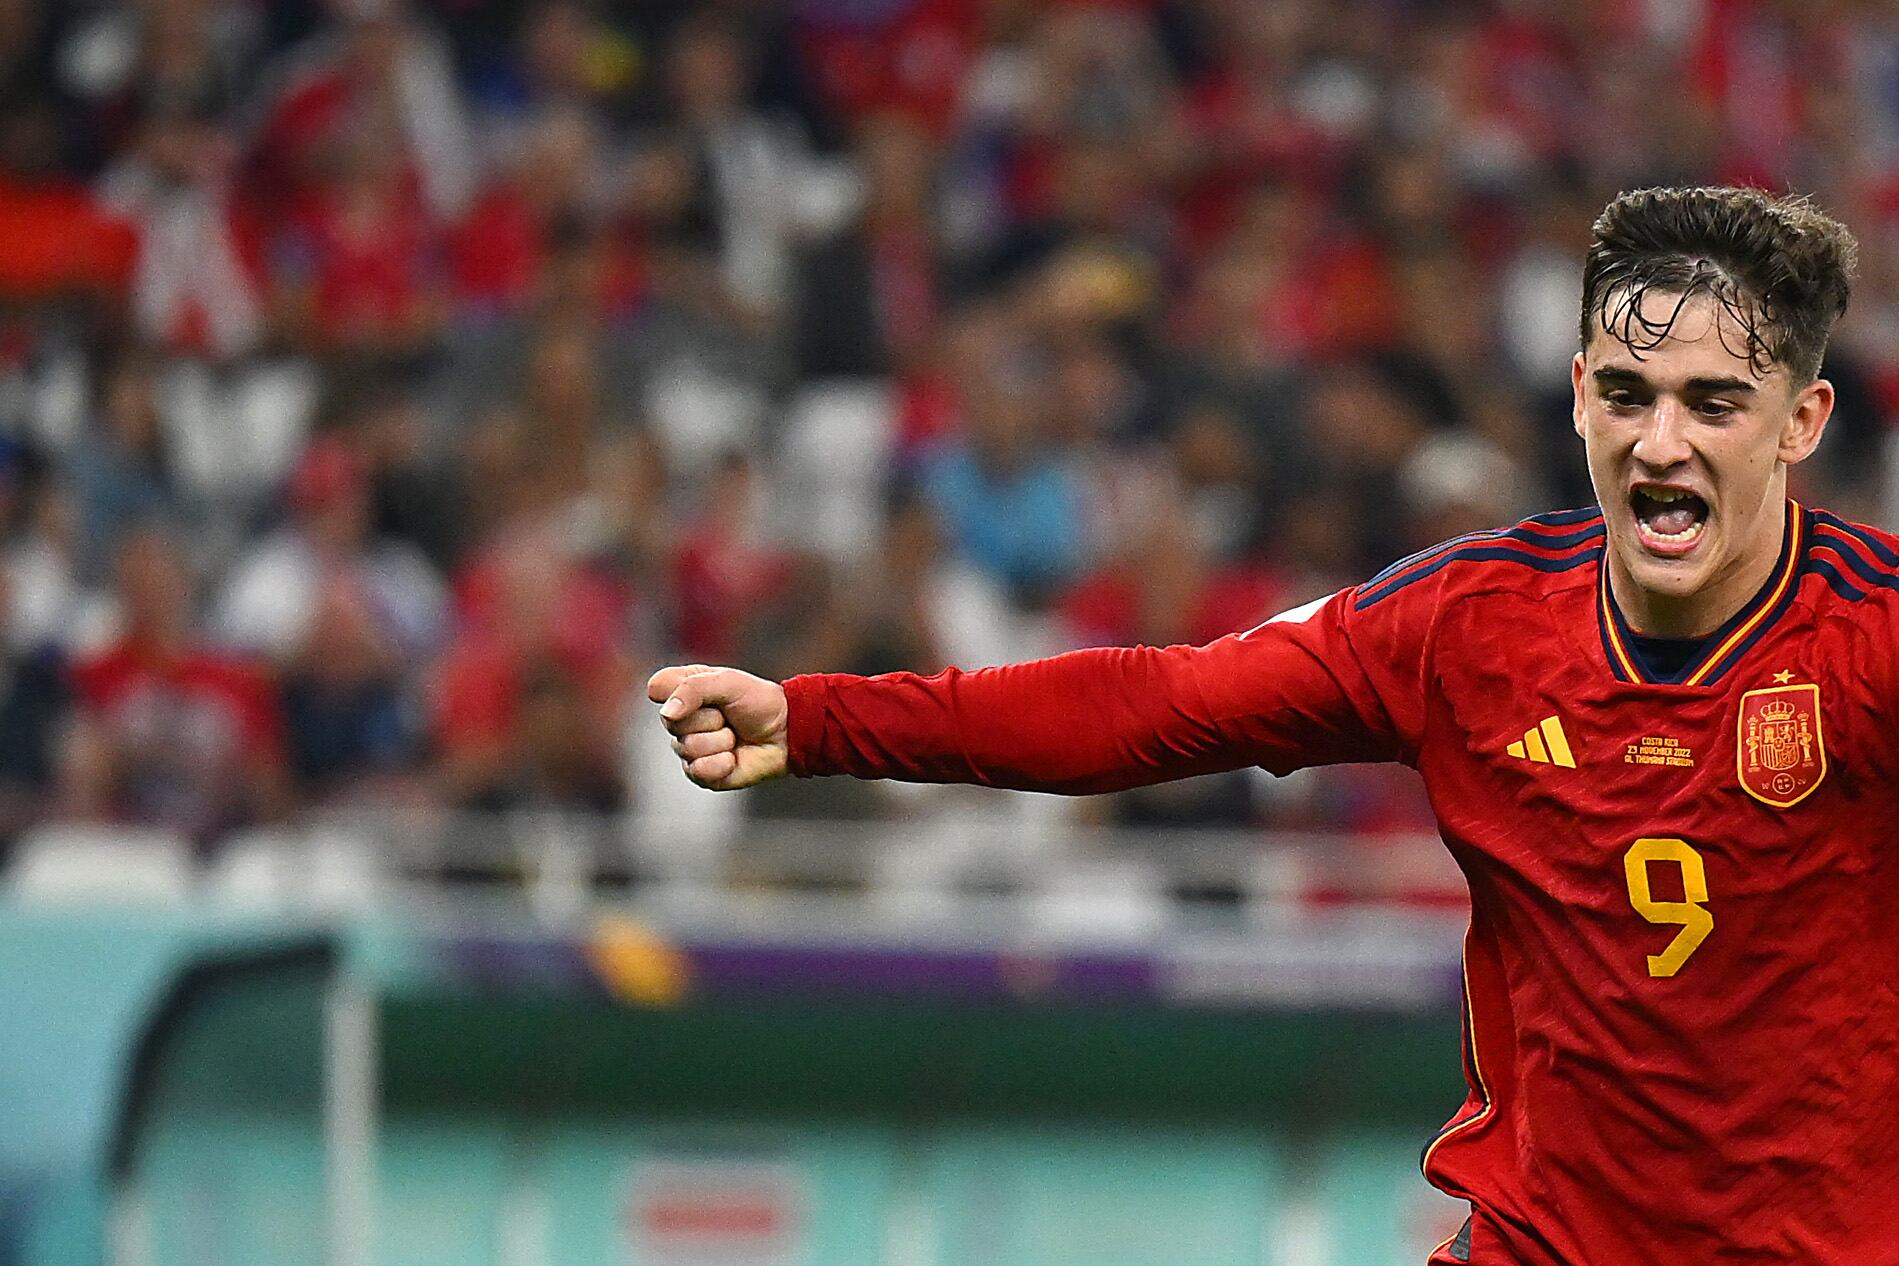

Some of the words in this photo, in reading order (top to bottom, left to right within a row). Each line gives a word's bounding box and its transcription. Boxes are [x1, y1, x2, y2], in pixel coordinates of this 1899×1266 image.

[1642, 737, 1663, 746] COSTA
[1628, 745, 1637, 754] 23
[1674, 749, 1691, 757] 2022
[1623, 838, 1714, 978] 9
